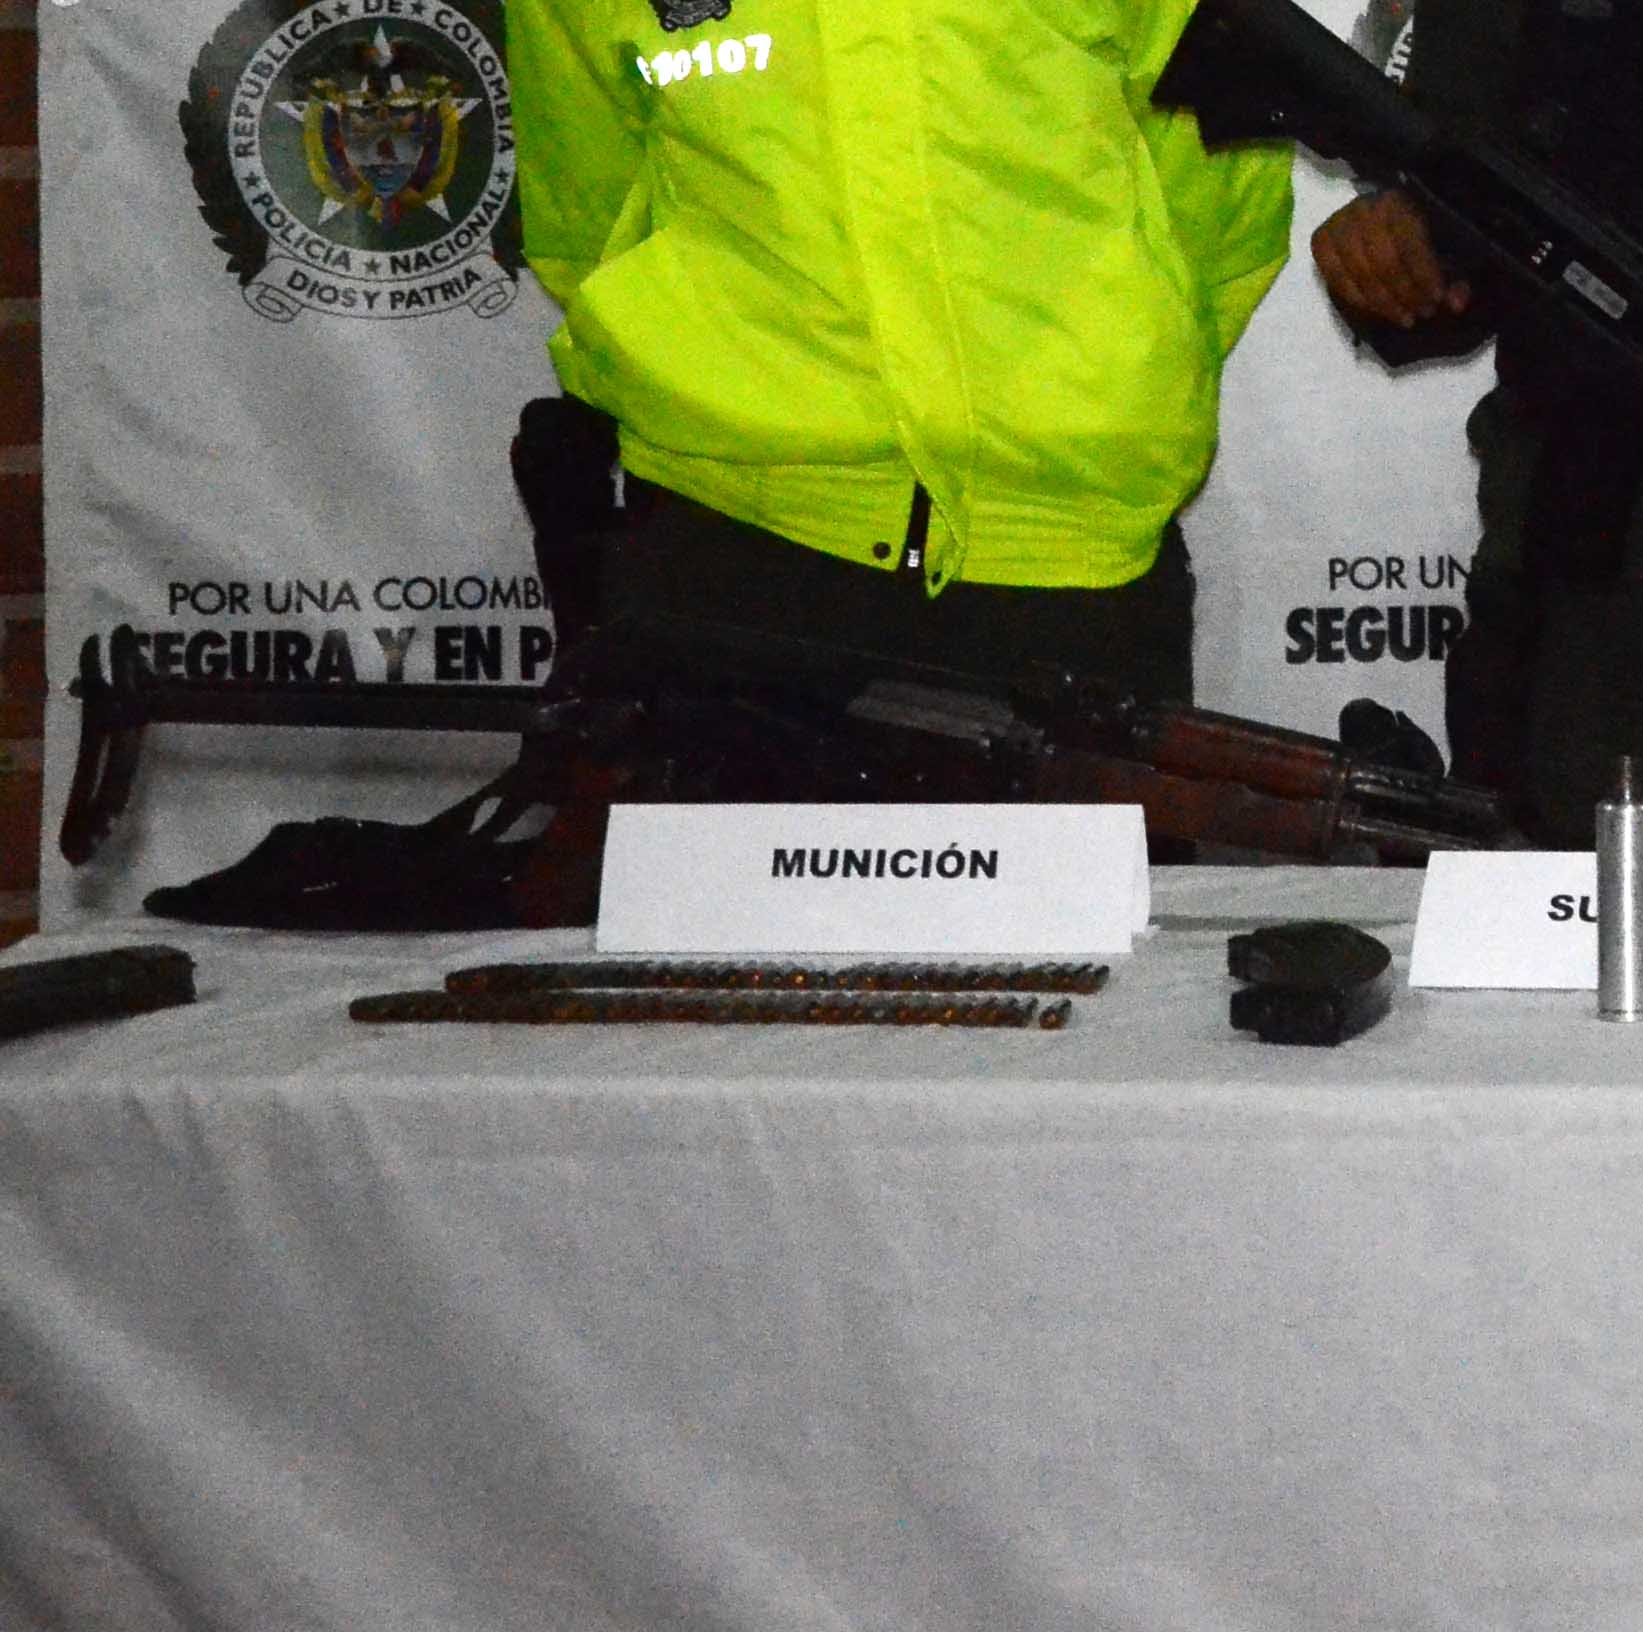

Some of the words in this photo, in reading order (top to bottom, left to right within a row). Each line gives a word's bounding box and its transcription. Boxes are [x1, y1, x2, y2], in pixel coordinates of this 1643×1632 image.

[433, 7, 516, 155] COLOMBIA
[389, 187, 507, 276] NACIONAL
[389, 266, 484, 311] PATRIA
[168, 581, 251, 615] POR
[265, 579, 361, 613] UNA
[1329, 556, 1407, 591] POR
[1420, 554, 1472, 589] UN
[374, 627, 416, 682] Y
[434, 626, 501, 681] EN
[1286, 605, 1465, 664] SEGUR
[771, 842, 998, 880] MUNICIÓN
